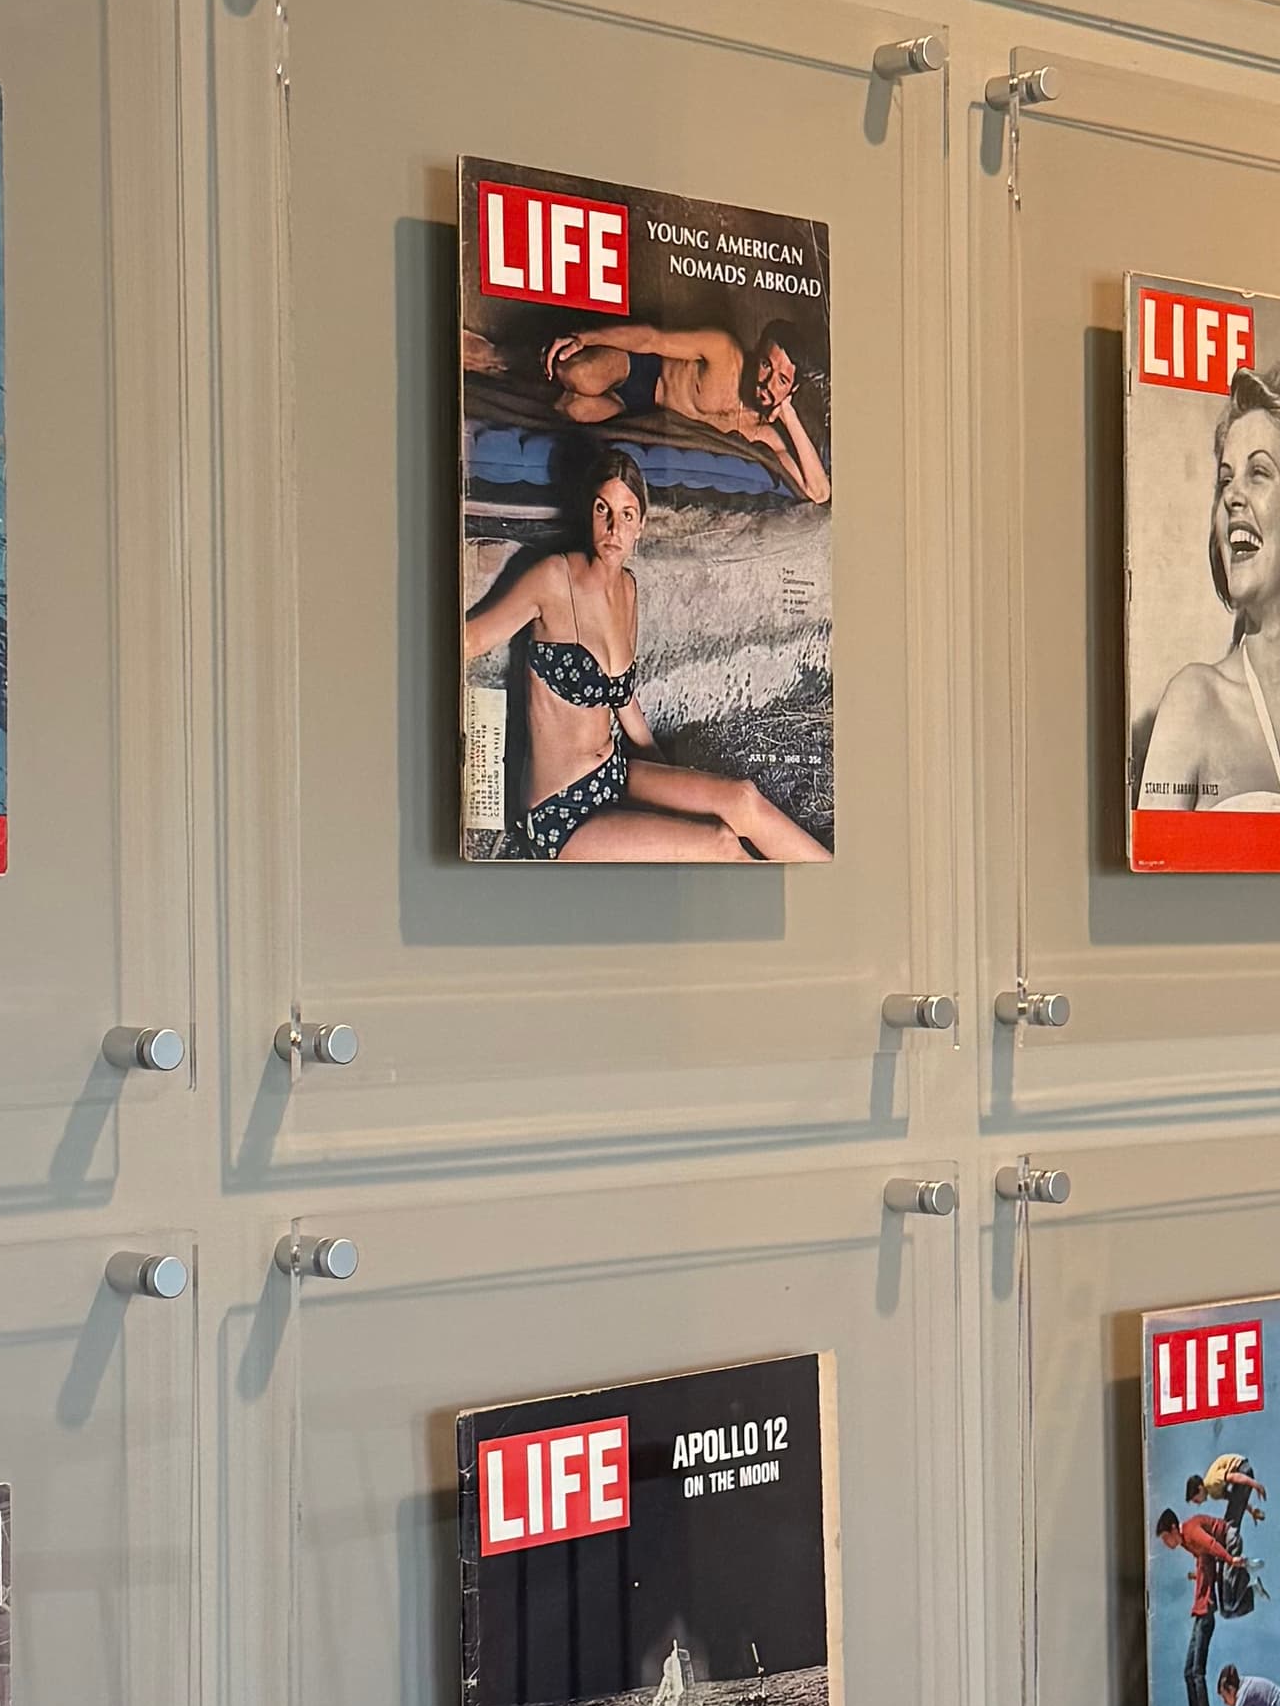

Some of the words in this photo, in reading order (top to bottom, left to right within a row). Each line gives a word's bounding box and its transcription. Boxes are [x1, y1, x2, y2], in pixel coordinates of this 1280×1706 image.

[488, 193, 622, 304] LIFE
[647, 221, 709, 249] YOUNG
[716, 233, 803, 265] AMERICAN
[670, 255, 746, 286] NOMADS
[753, 270, 821, 297] ABROAD
[1144, 298, 1249, 386] LIFE
[1159, 1330, 1259, 1416] LIFE
[673, 1422, 758, 1469] APOLLO
[763, 1416, 788, 1451] 12
[487, 1428, 623, 1543] LIFE
[684, 1475, 704, 1498] ON
[709, 1469, 735, 1493] THE
[740, 1460, 779, 1487] MOON
